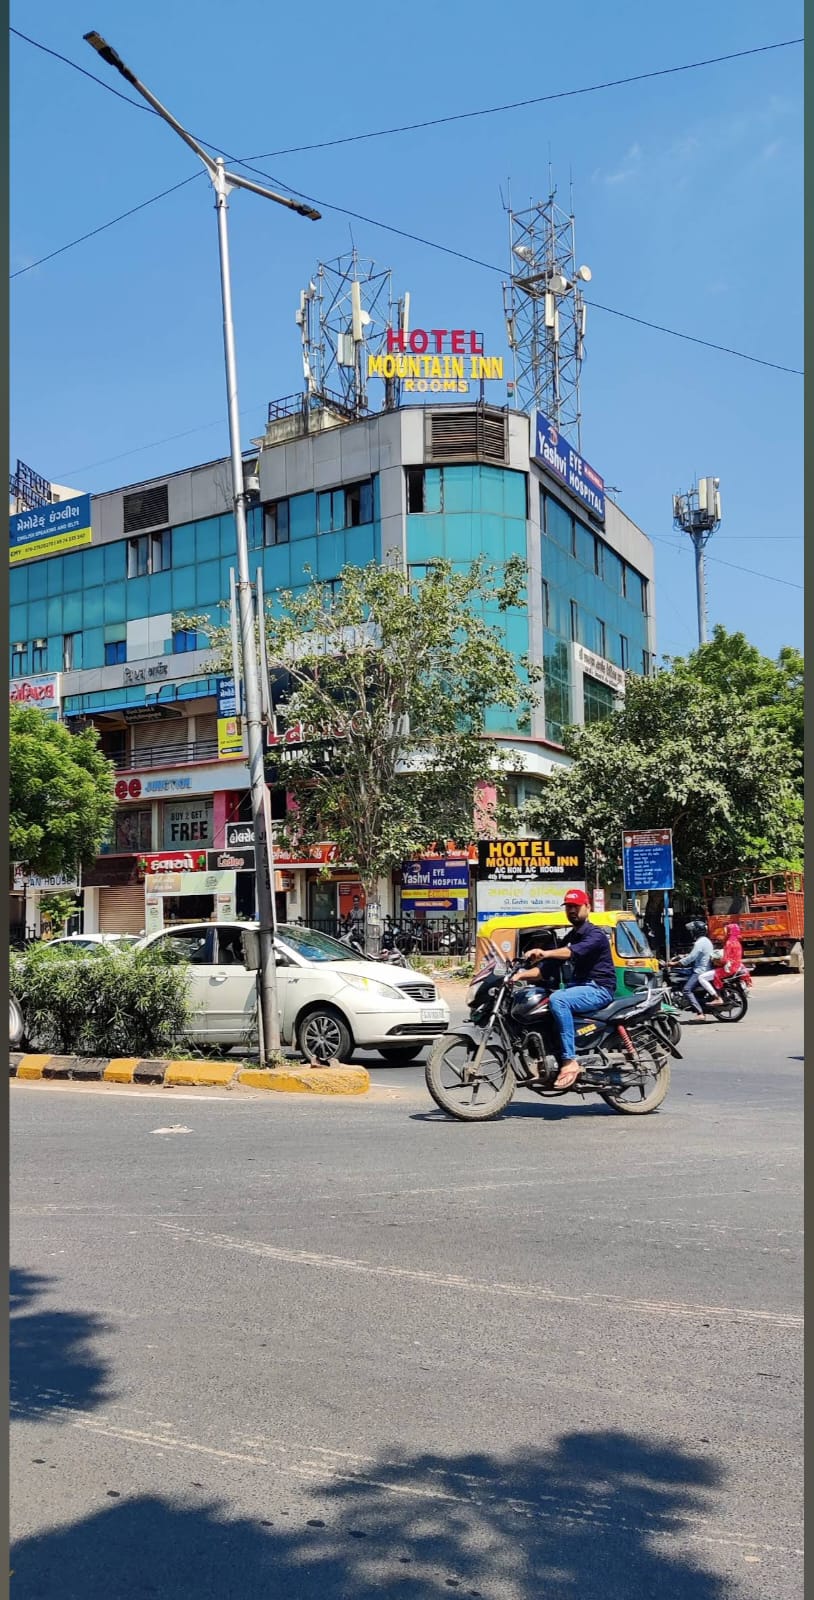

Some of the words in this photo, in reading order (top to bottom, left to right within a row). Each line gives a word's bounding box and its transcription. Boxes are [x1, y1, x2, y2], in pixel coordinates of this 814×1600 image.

[387, 328, 484, 354] HOTEL
[368, 354, 465, 379] MOUNTAIN
[470, 356, 504, 379] INN
[404, 380, 469, 393] ROOMS
[538, 430, 567, 476] Yashvi
[569, 450, 583, 476] EYE
[569, 470, 603, 514] HOSPITAL
[170, 811, 184, 821] BUY
[191, 809, 202, 820] GET
[170, 820, 208, 841] FREE
[489, 841, 555, 857] HOTEL
[486, 857, 550, 867] MOUNTAIN
[557, 856, 579, 866] INN
[433, 868, 445, 876] EYE
[507, 866, 522, 874] NON
[403, 871, 431, 884] Yashvi
[433, 878, 467, 886] HOSPITAL
